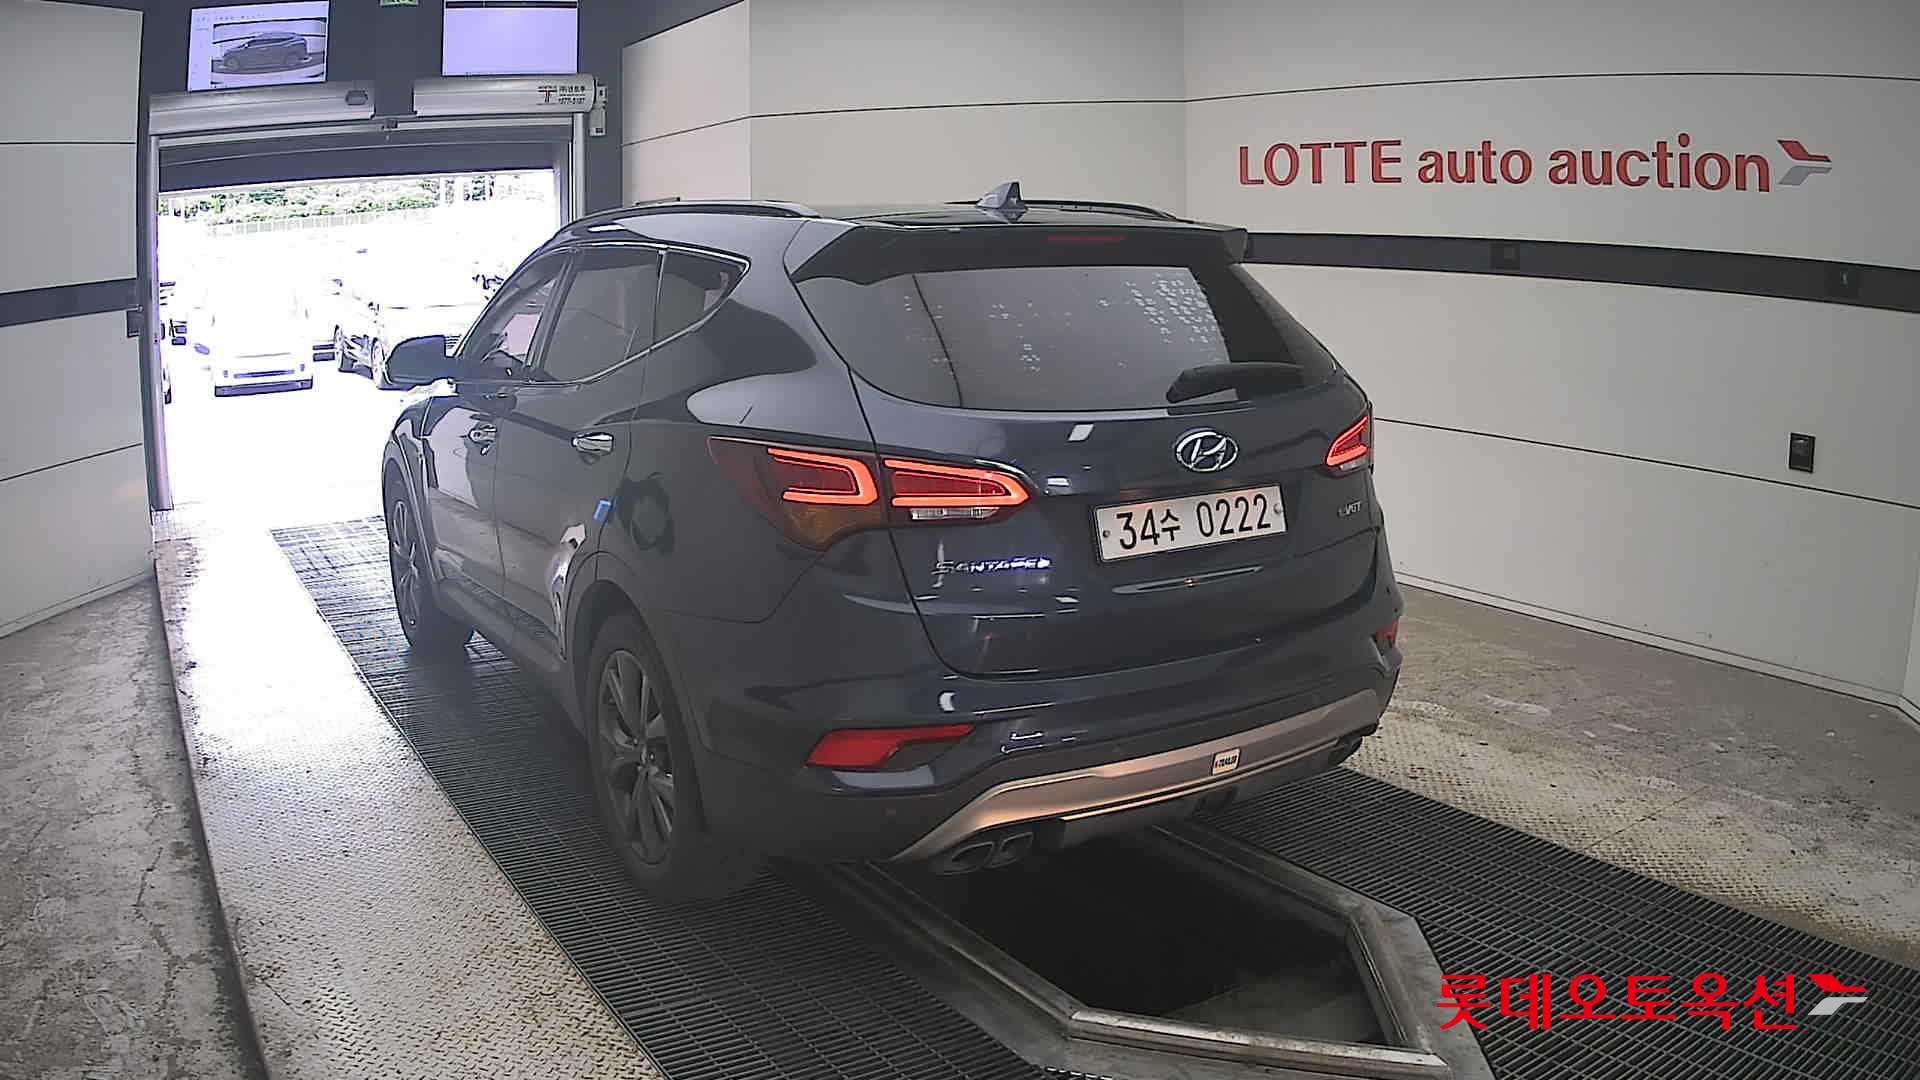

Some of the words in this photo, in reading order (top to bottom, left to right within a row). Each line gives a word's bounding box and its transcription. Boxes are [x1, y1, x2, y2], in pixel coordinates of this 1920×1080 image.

[1239, 139, 1402, 185] LOTTE
[1418, 140, 1533, 185] auto
[1548, 133, 1770, 193] auction
[1116, 508, 1181, 550] 34수
[1196, 494, 1271, 538] 0222
